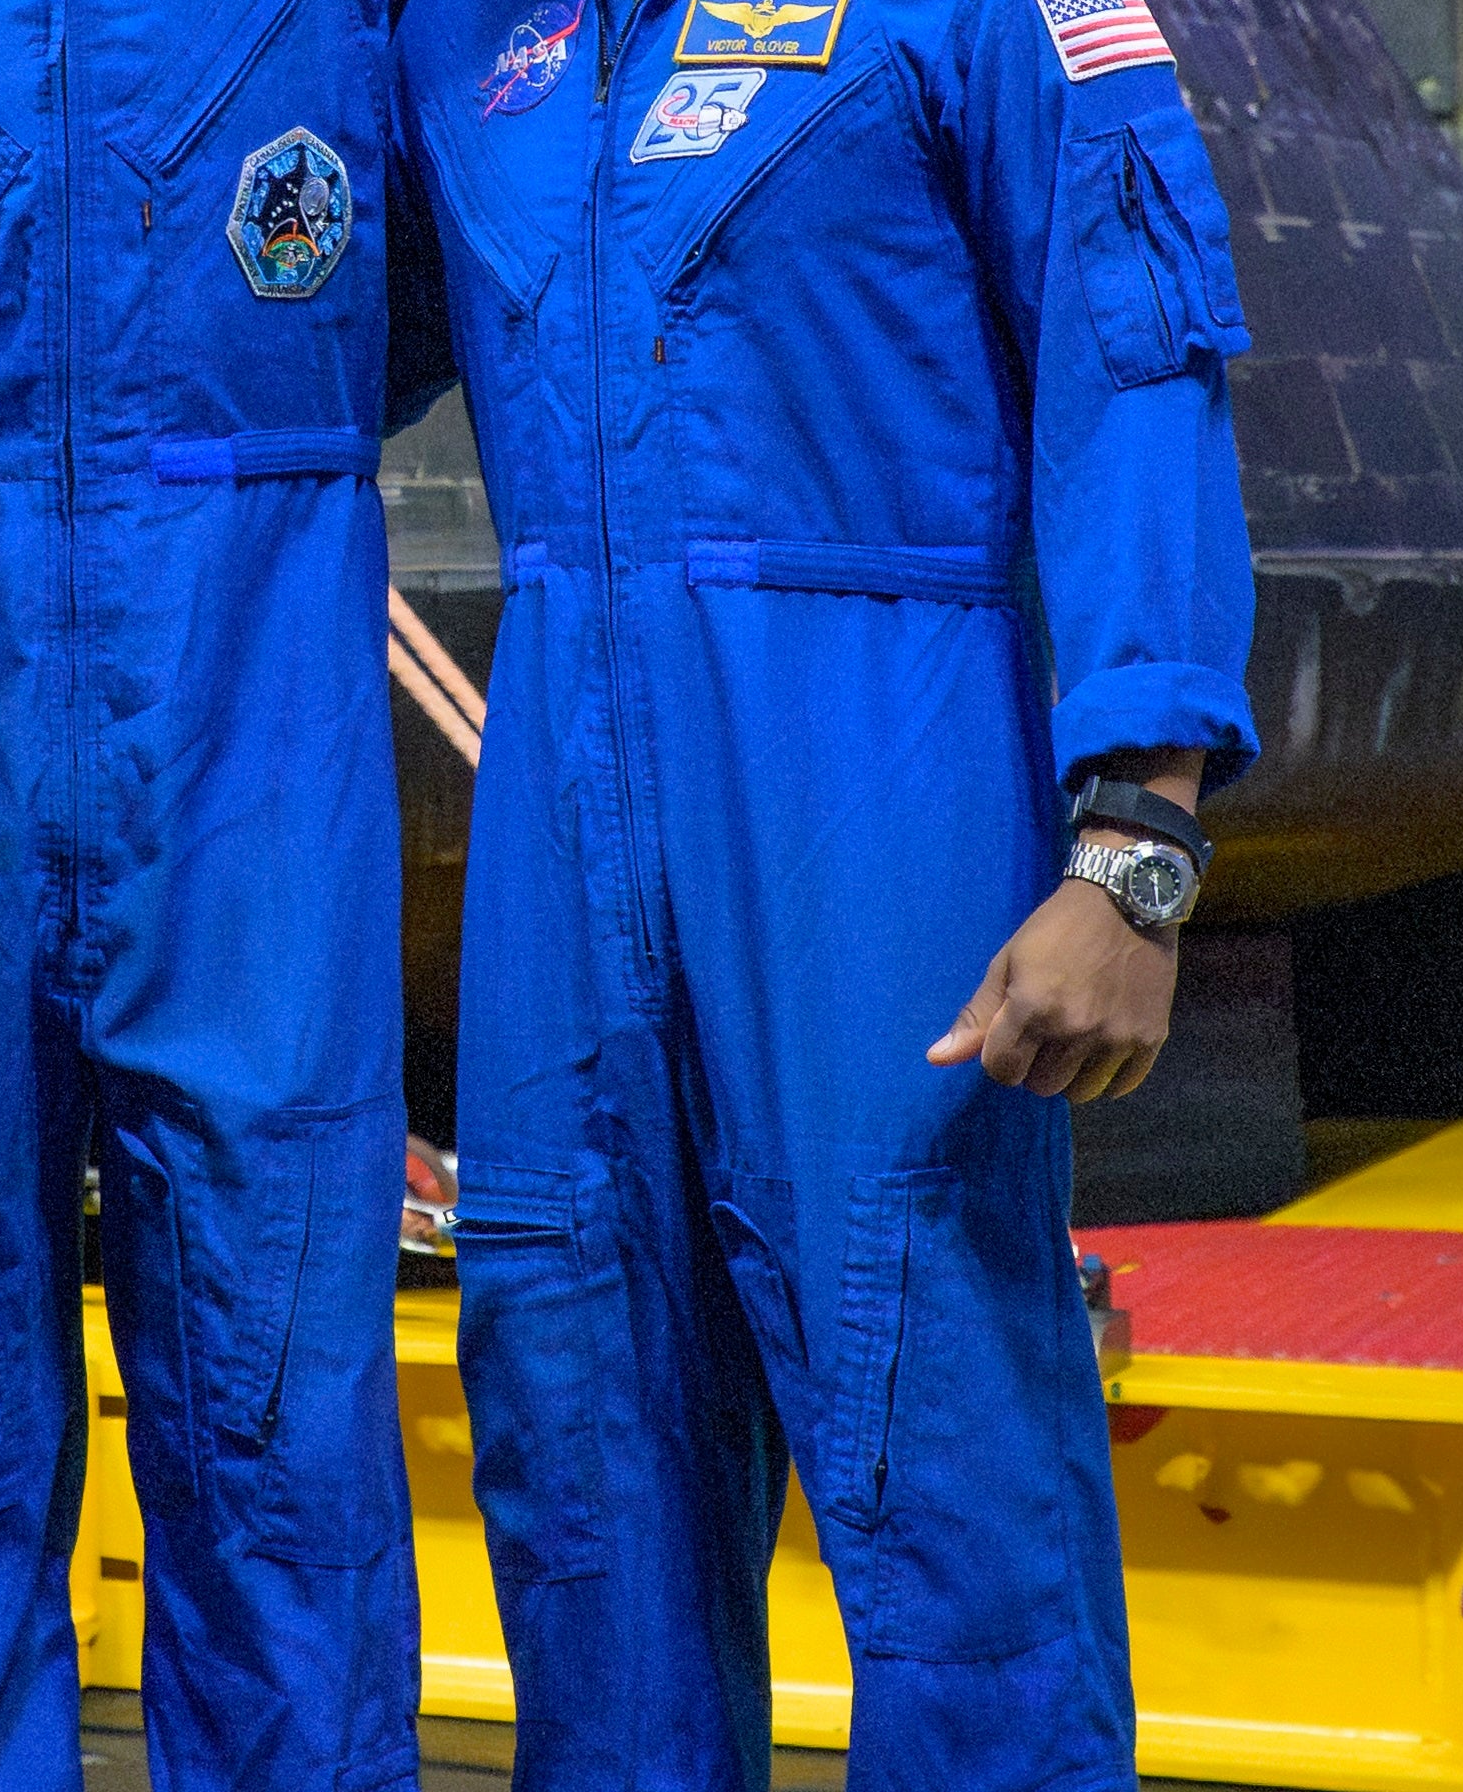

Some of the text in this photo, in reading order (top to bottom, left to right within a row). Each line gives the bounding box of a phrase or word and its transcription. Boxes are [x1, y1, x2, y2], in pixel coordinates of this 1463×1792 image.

[495, 39, 568, 75] NASA
[707, 39, 800, 54] VICTOR GLOVER
[645, 81, 742, 148] 25
[669, 117, 699, 126] MACH
